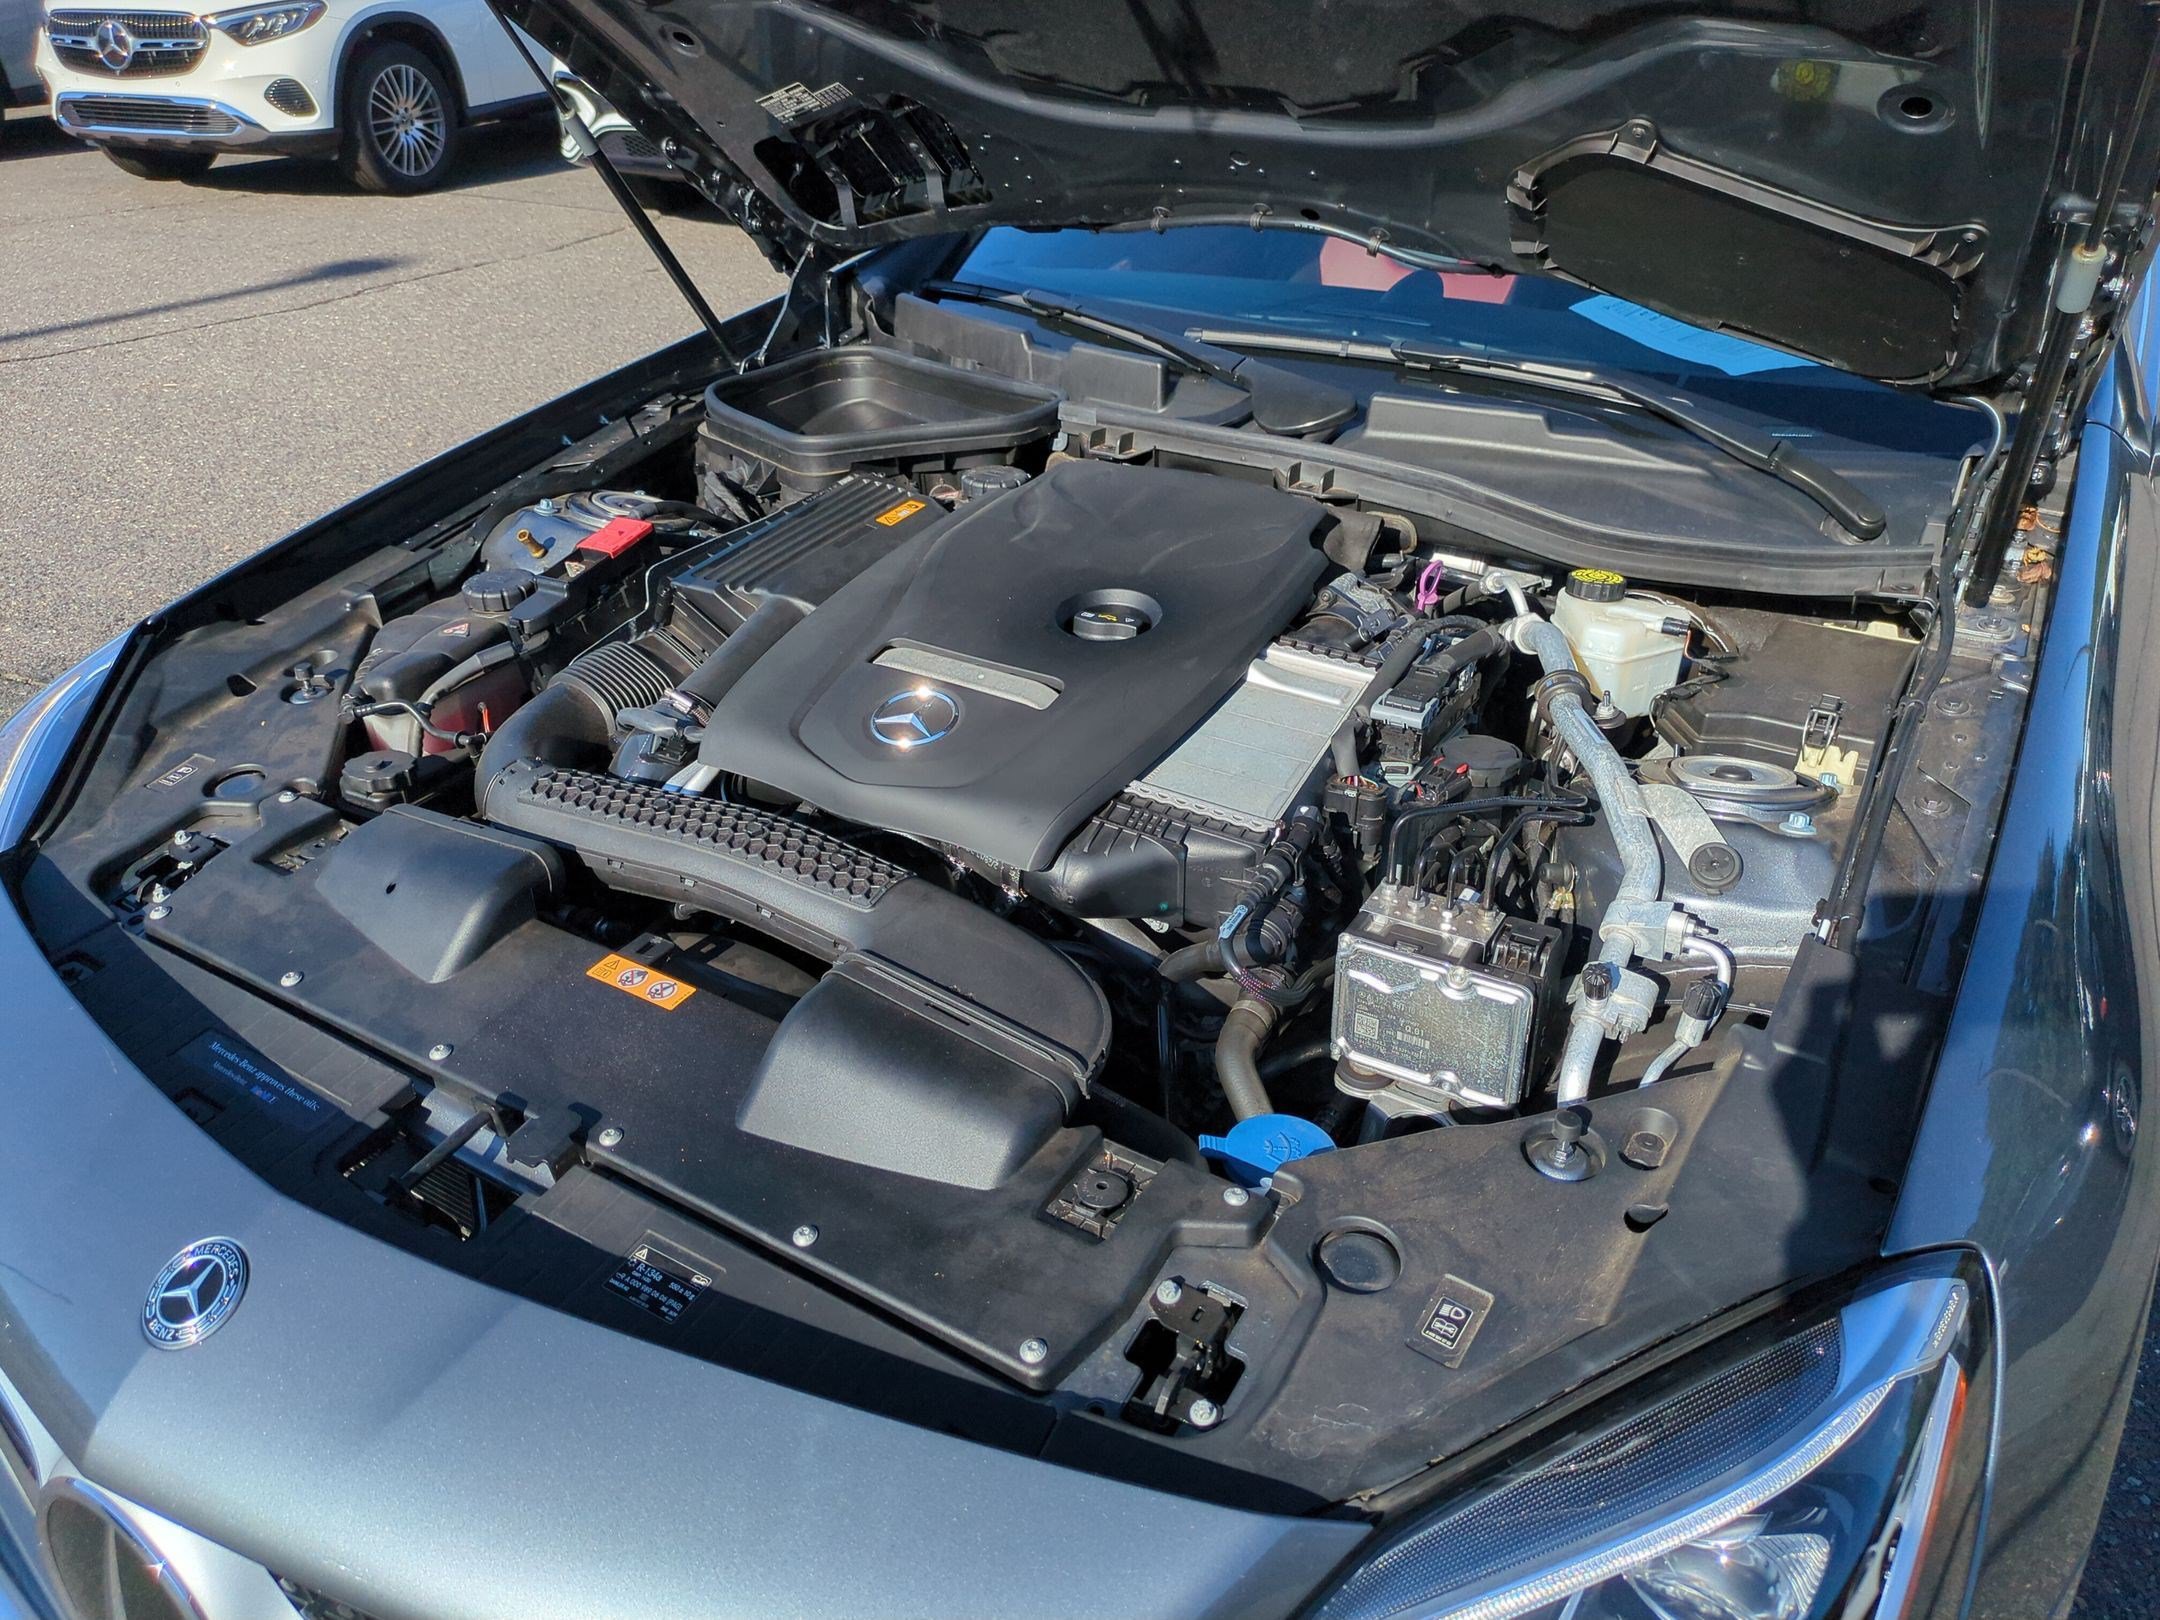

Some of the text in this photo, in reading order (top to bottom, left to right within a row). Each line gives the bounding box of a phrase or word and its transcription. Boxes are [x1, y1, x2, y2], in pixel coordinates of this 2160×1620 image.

[284, 1086, 305, 1102] these
[194, 1244, 239, 1279] MERCEDES
[636, 1263, 663, 1282] R-134a
[630, 1279, 642, 1288] 000
[149, 1319, 176, 1340] BENZ
